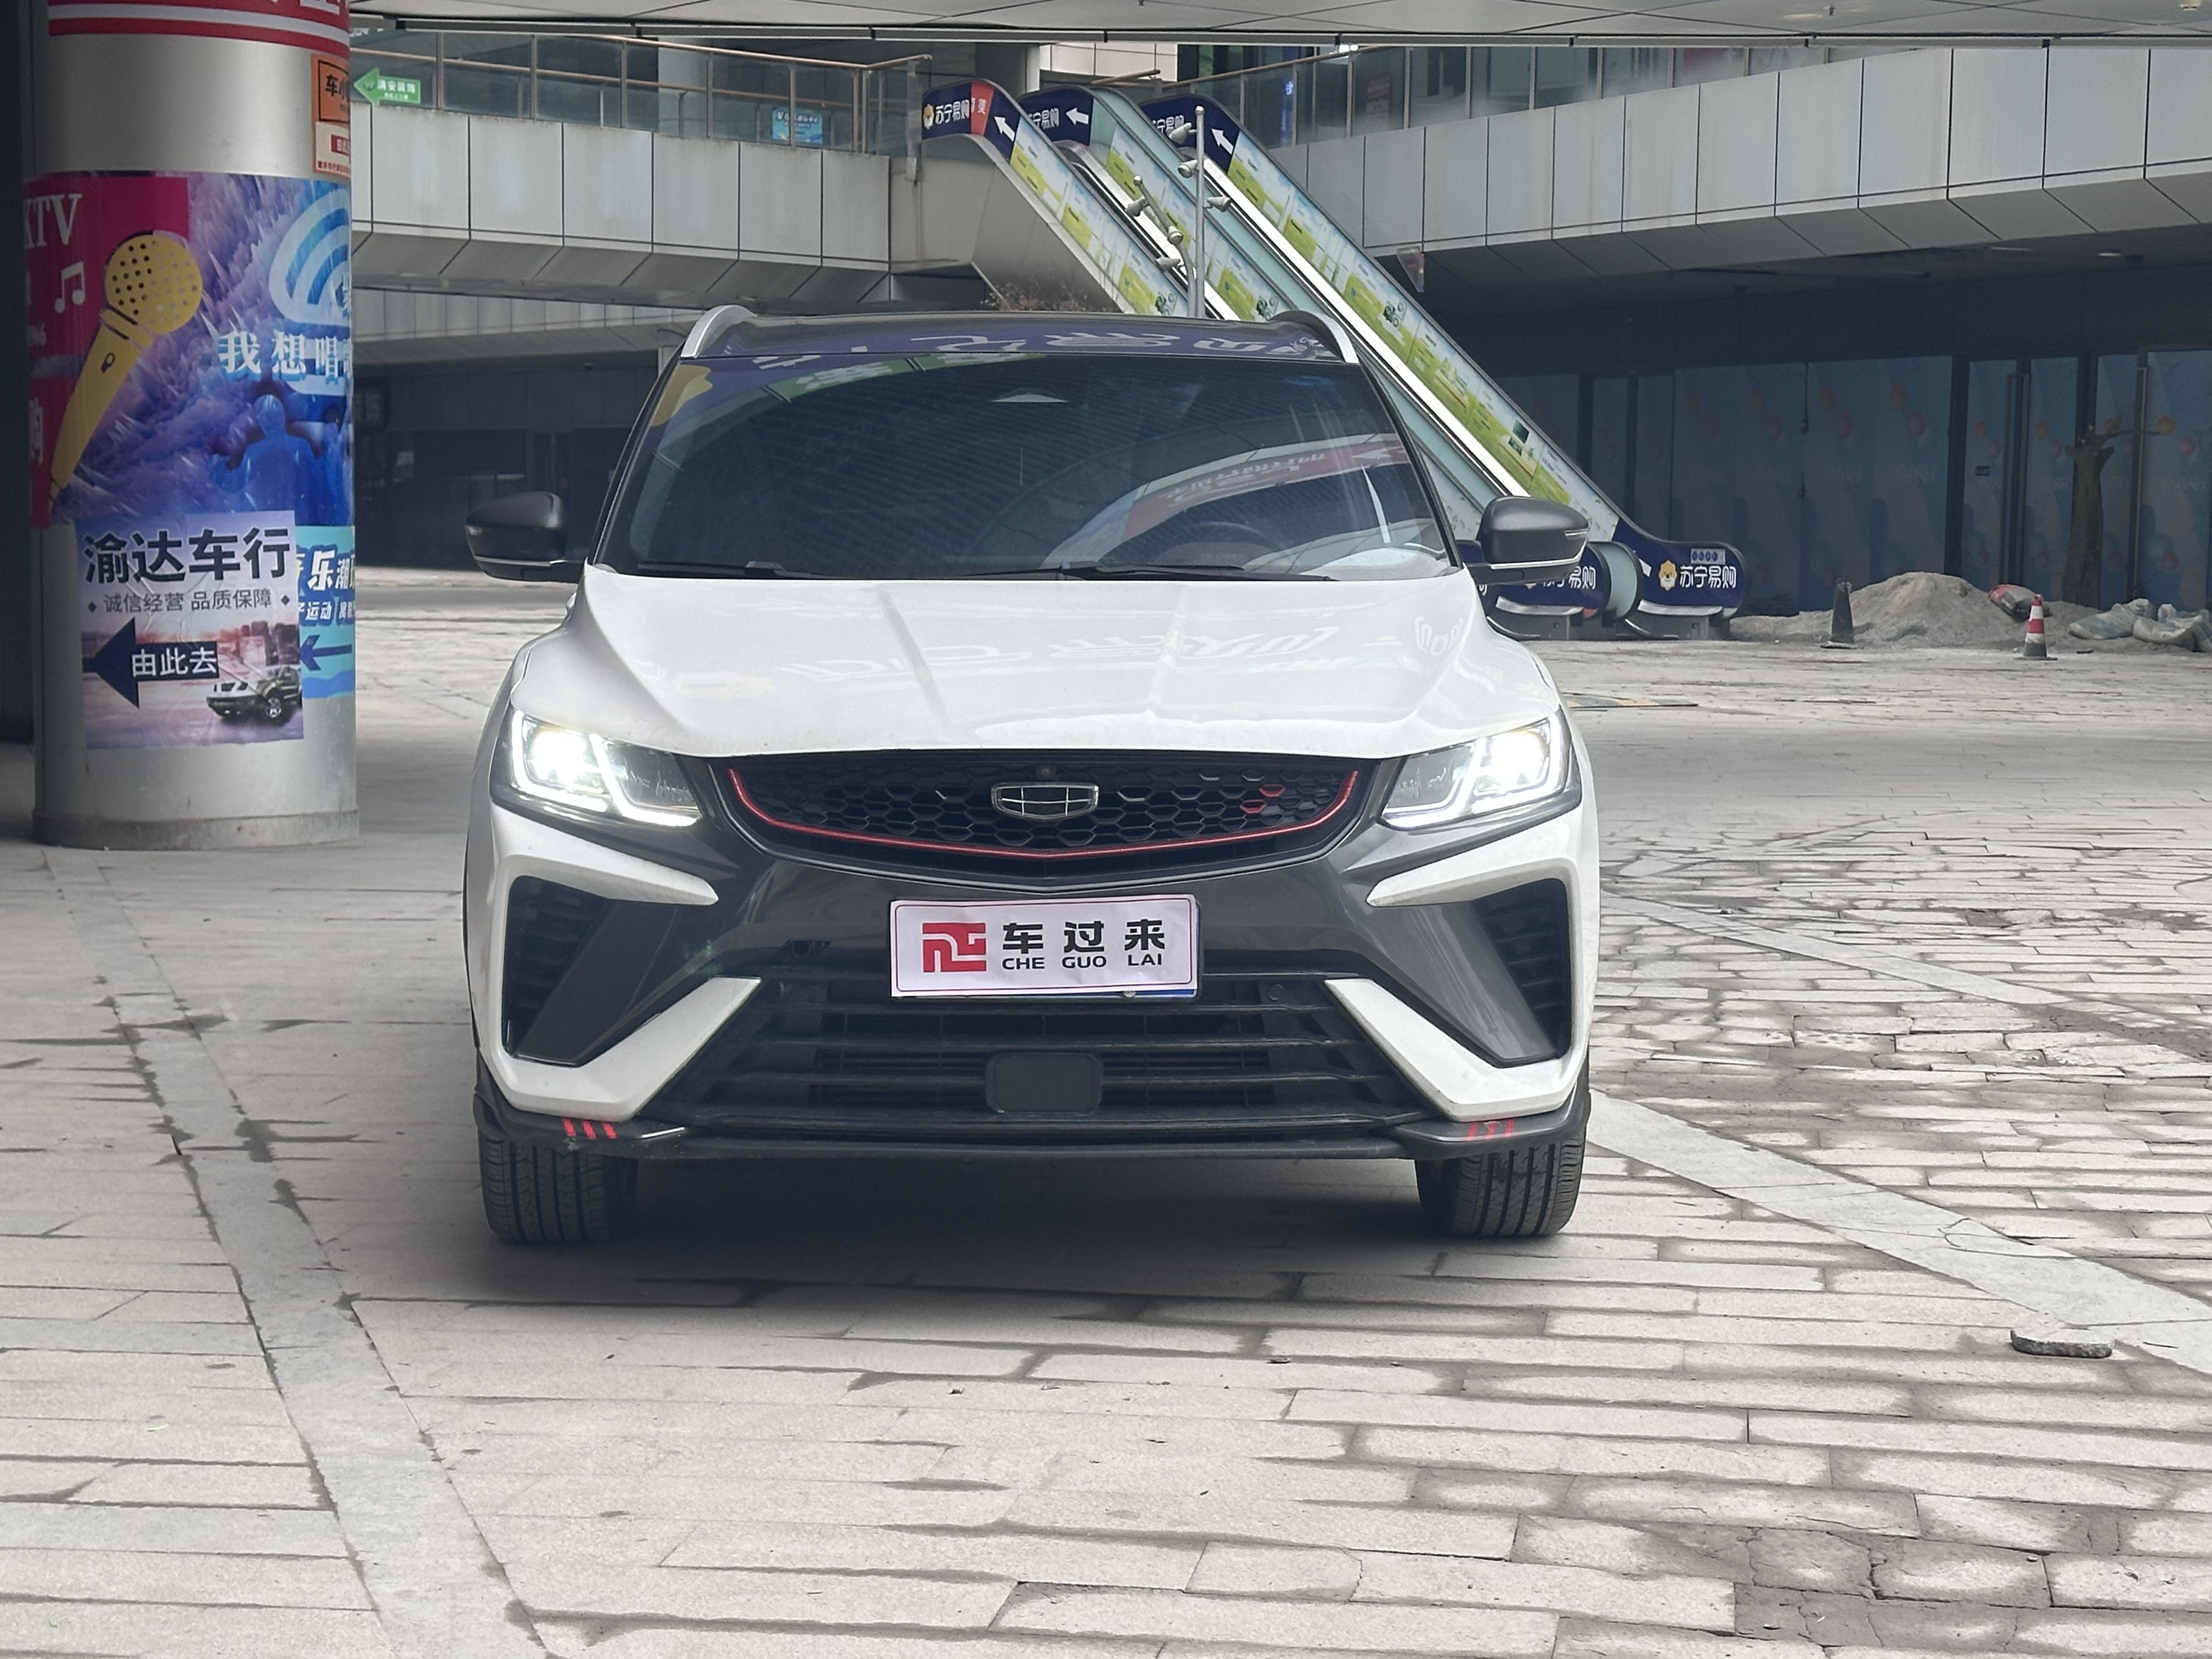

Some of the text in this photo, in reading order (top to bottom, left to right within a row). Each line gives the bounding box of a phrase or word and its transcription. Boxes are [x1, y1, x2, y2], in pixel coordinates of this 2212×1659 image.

[935, 100, 969, 125] 苏宁易购
[1029, 108, 1059, 129] 宁易购
[1153, 115, 1184, 136] 宁易购
[84, 527, 290, 584] 渝达车行
[1680, 566, 1736, 589] 苏宁易购
[104, 589, 272, 613] 诚信经营 品质保障
[132, 647, 218, 677] 由此去
[1002, 919, 1165, 955] 车过来
[1002, 953, 1162, 970] CHE GUO LAI
